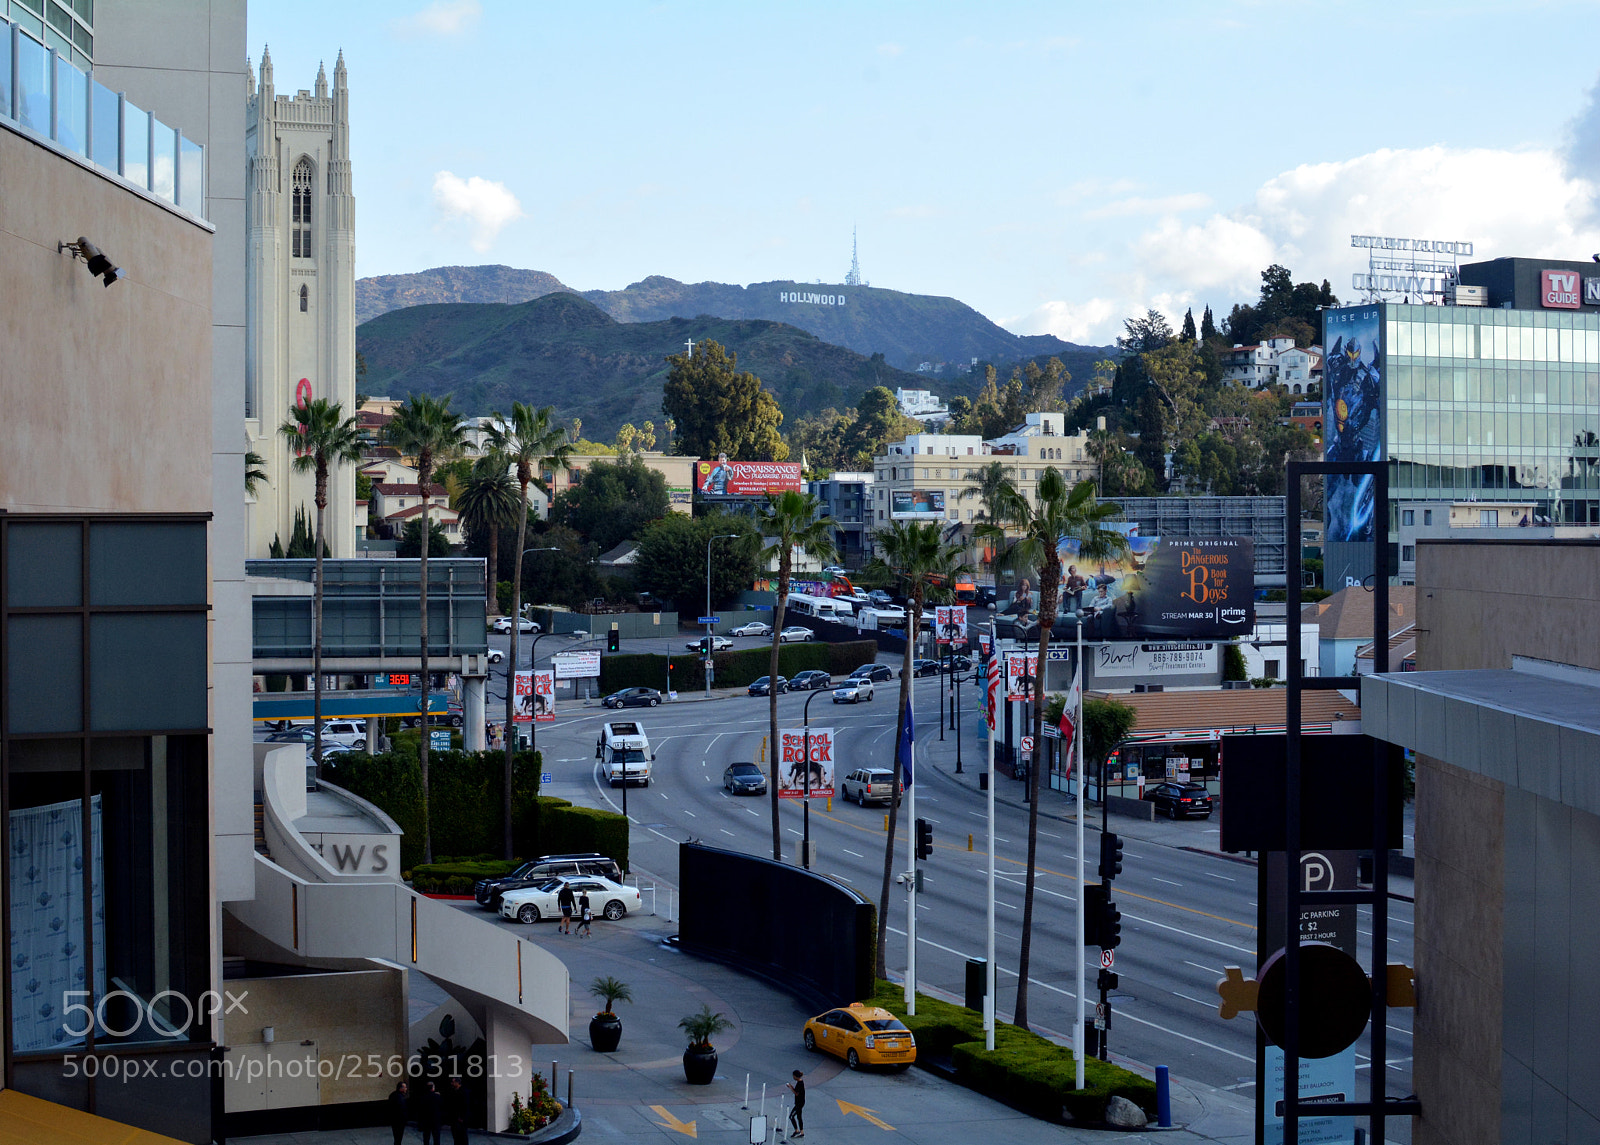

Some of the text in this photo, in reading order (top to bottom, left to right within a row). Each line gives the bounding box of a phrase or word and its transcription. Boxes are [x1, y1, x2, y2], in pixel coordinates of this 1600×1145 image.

[1548, 274, 1575, 292] TV
[780, 292, 846, 306] HOLLYWOOD
[1547, 292, 1578, 304] GUIDE
[1327, 311, 1378, 324] RISE UP
[1161, 612, 1188, 620] STREAM
[1221, 607, 1246, 616] prime
[937, 615, 965, 625] ROCK
[1010, 657, 1039, 666] SCHOO
[1153, 652, 1203, 663] 866-789-9074
[515, 683, 552, 696] ROCK
[782, 733, 832, 746] SCHOOL
[782, 746, 832, 763] ROCK
[1310, 909, 1340, 919] PARKING
[1307, 921, 1318, 932] $2
[1318, 931, 1337, 939] HOURS
